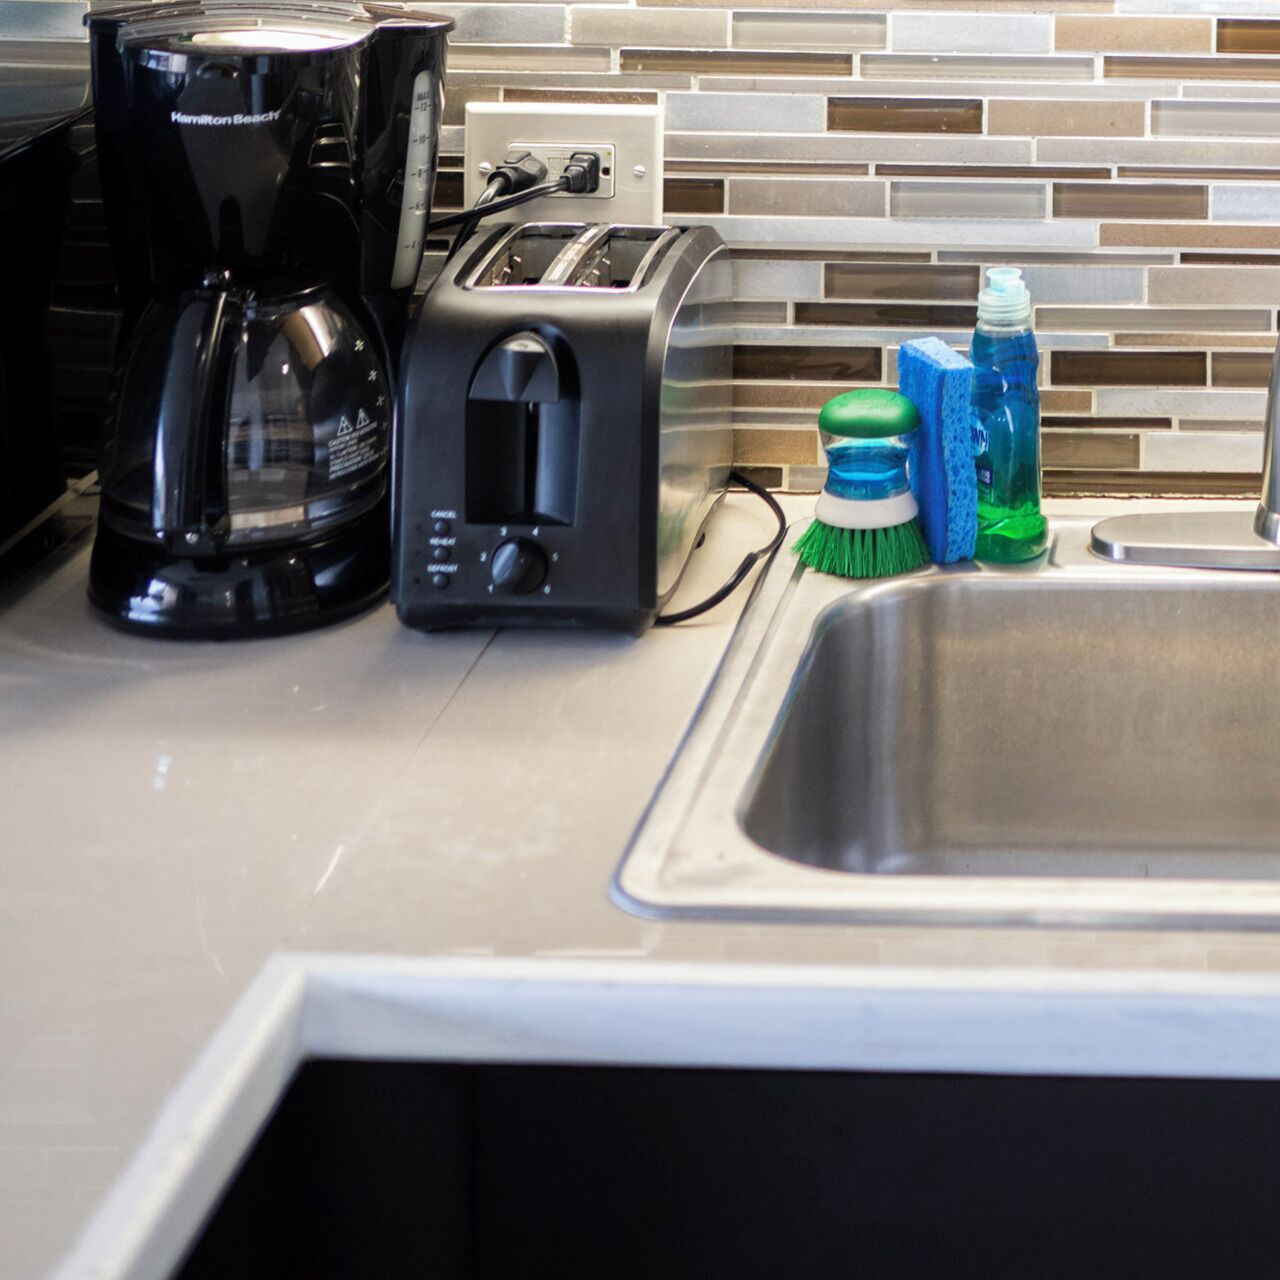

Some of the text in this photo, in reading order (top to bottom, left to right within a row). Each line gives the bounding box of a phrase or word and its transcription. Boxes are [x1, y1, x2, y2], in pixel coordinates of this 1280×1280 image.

[171, 109, 281, 126] Hamilton Beach
[431, 510, 456, 519] CANCEL
[500, 526, 507, 536] 3
[532, 526, 539, 536] 4
[429, 537, 456, 546] REHEAT
[480, 551, 487, 562] 2
[427, 563, 458, 573] DEFROST
